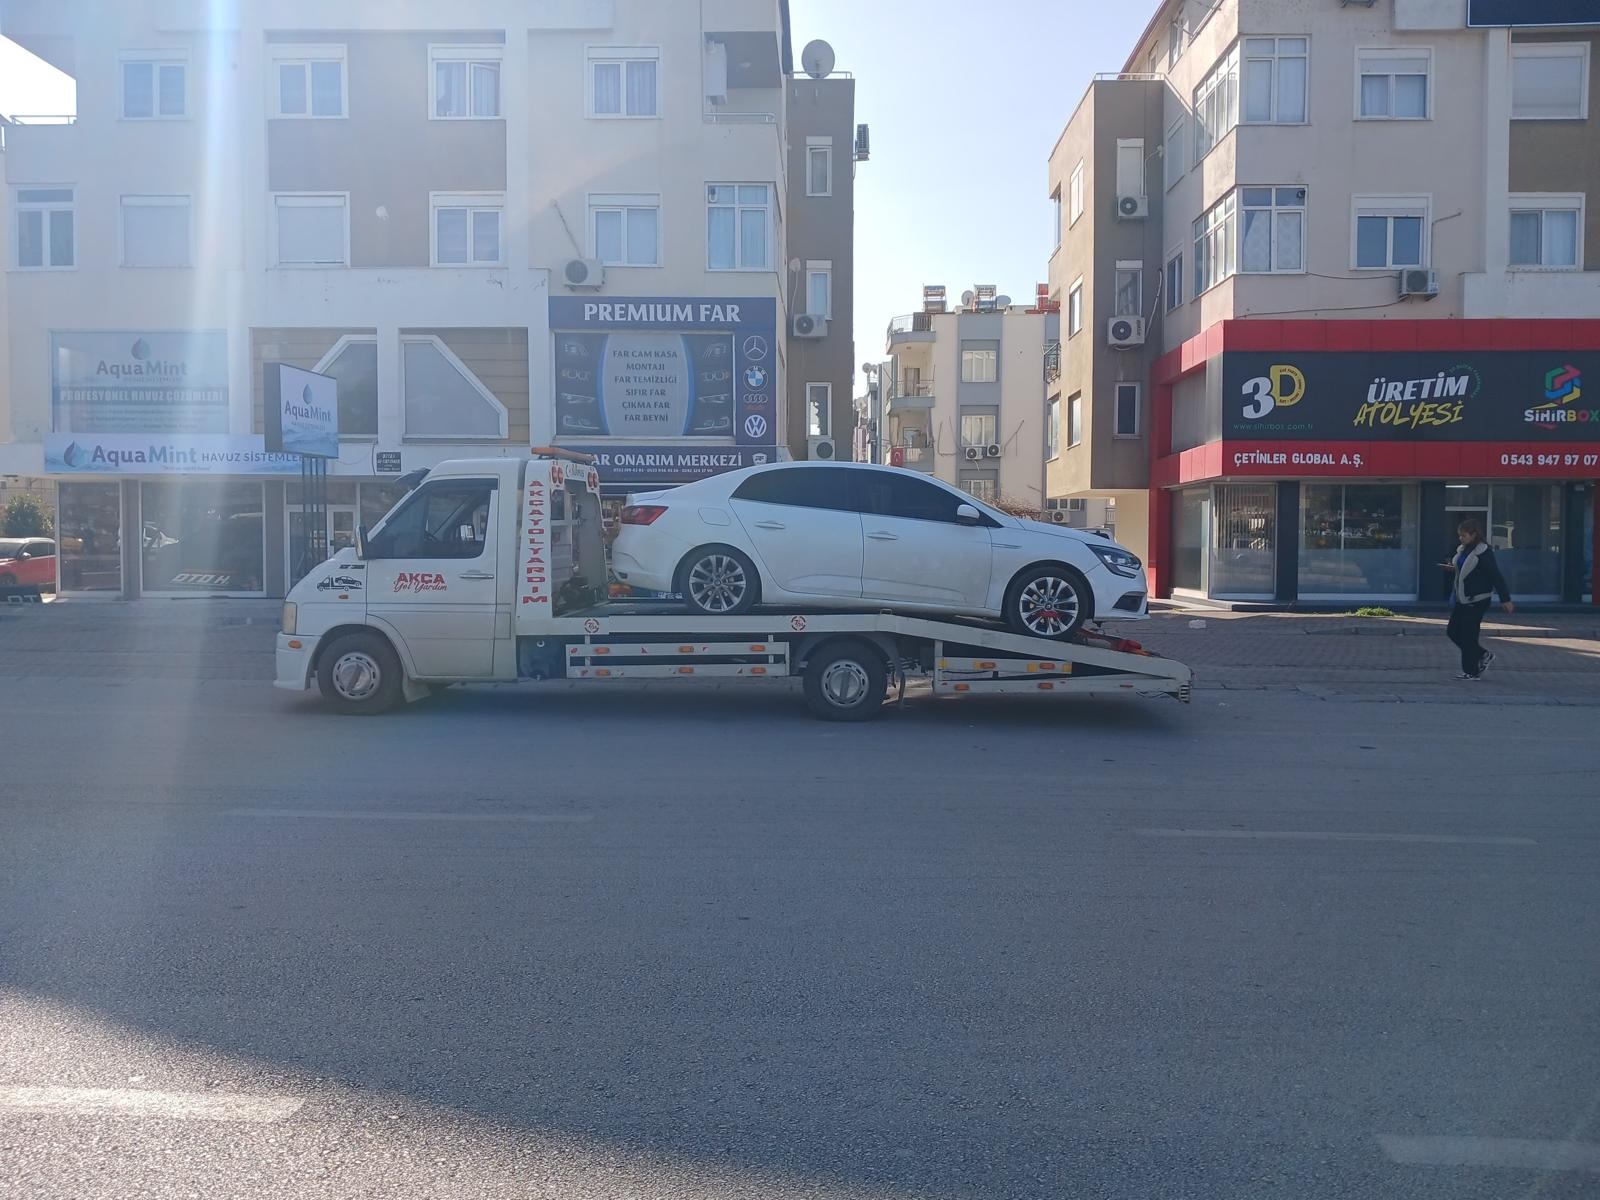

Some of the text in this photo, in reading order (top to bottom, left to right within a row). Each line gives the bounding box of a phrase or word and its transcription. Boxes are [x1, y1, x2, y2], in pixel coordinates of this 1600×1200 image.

[584, 303, 742, 322] PREMIUM FAR
[612, 350, 629, 358] FAR
[654, 350, 678, 358] KASA
[96, 361, 187, 379] AquaMint
[614, 375, 631, 383] FAR
[1367, 371, 1470, 404] ÜRETİM
[649, 388, 666, 396] FAR
[1241, 364, 1306, 419] 3D
[284, 400, 331, 422] AquaMint
[653, 401, 670, 409] FAR
[624, 414, 641, 422] FAR
[1353, 400, 1464, 429] ATOLYESİ
[91, 445, 303, 467] AquaMint HAVUZ SİSTEMLE
[591, 453, 611, 466] AR
[614, 453, 674, 466] ONARIM
[677, 452, 742, 466] MERKEZİ
[1234, 450, 1287, 467] ÇETİNLER
[1292, 453, 1336, 465] GLOBAL
[1537, 454, 1560, 465] 947
[1564, 454, 1579, 465] 97
[1583, 454, 1598, 465] 07
